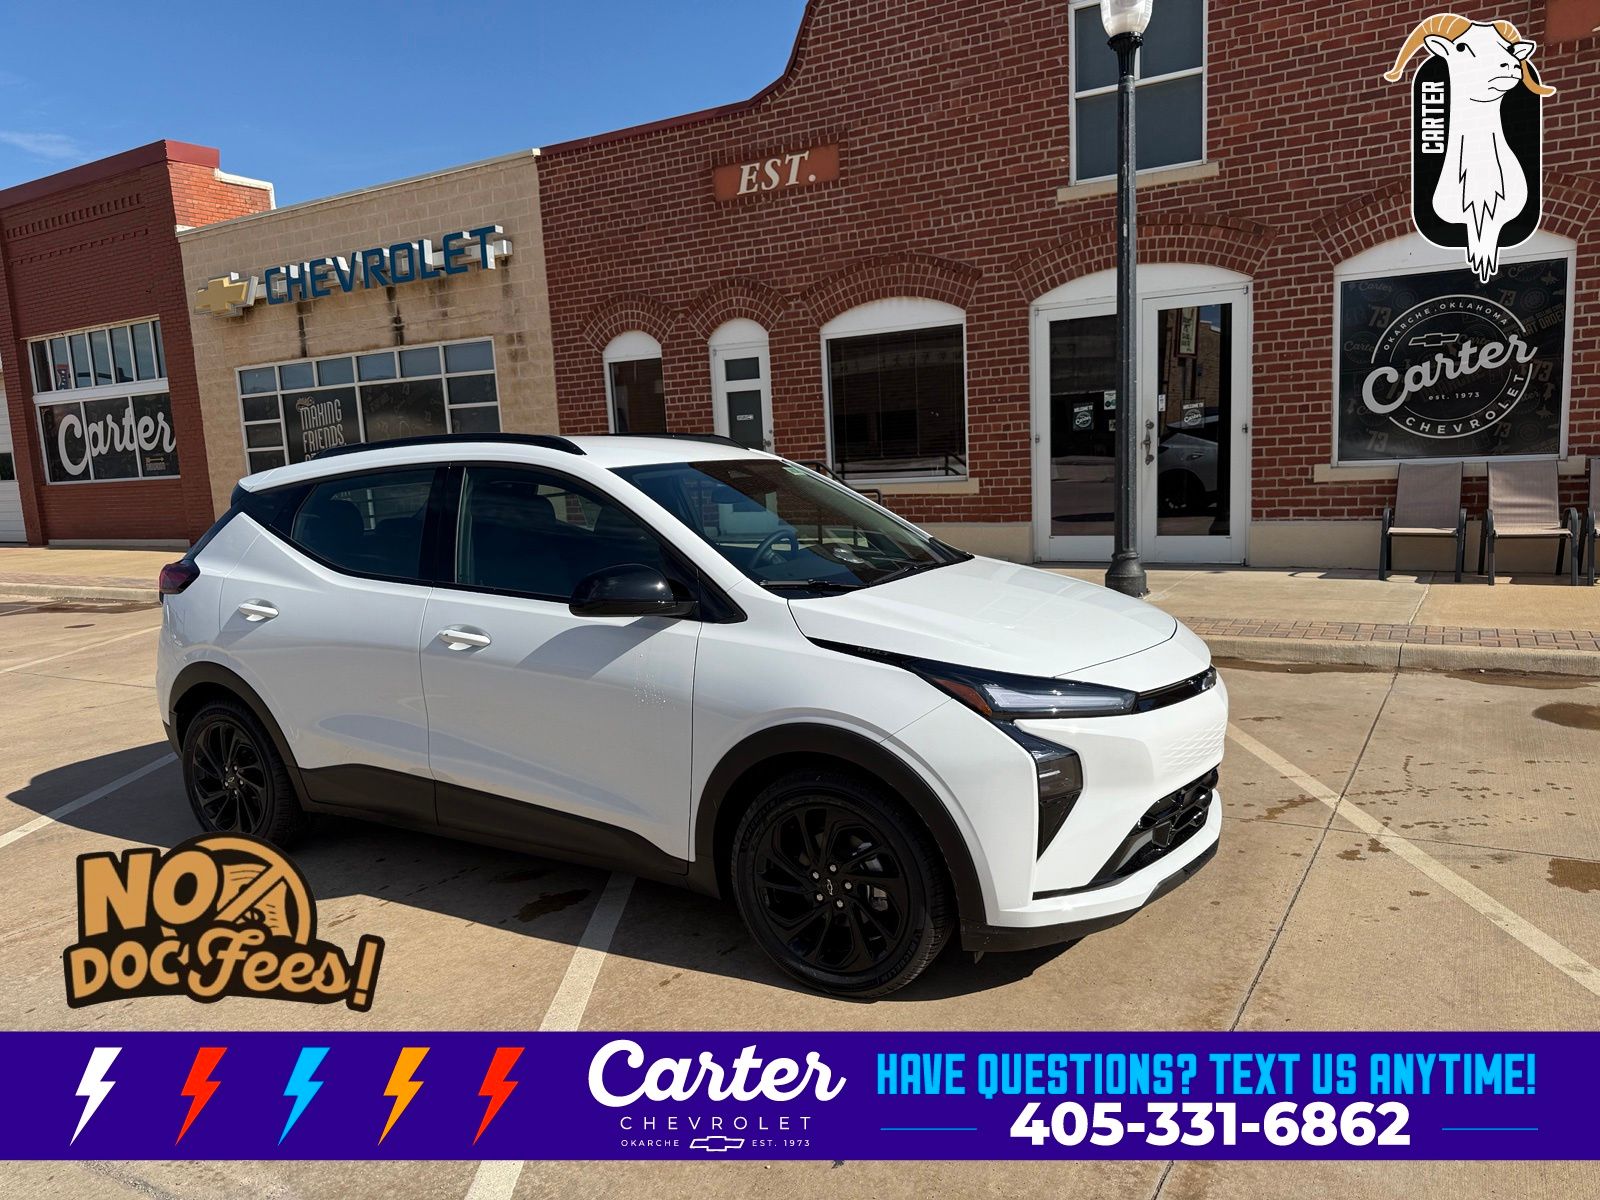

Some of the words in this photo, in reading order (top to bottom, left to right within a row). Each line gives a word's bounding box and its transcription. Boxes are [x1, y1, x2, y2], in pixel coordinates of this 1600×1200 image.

[737, 150, 816, 195] EST.
[265, 225, 502, 305] CHEVROLET
[1439, 302, 1508, 326] OKLAHOMA
[1362, 334, 1538, 414] Carter
[1428, 393, 1450, 401] est.
[1455, 391, 1481, 399] 1973
[300, 399, 343, 430] MAKING
[1405, 373, 1525, 434] CHEVROLET
[58, 406, 177, 476] Carter
[302, 423, 347, 453] FRIENDS.
